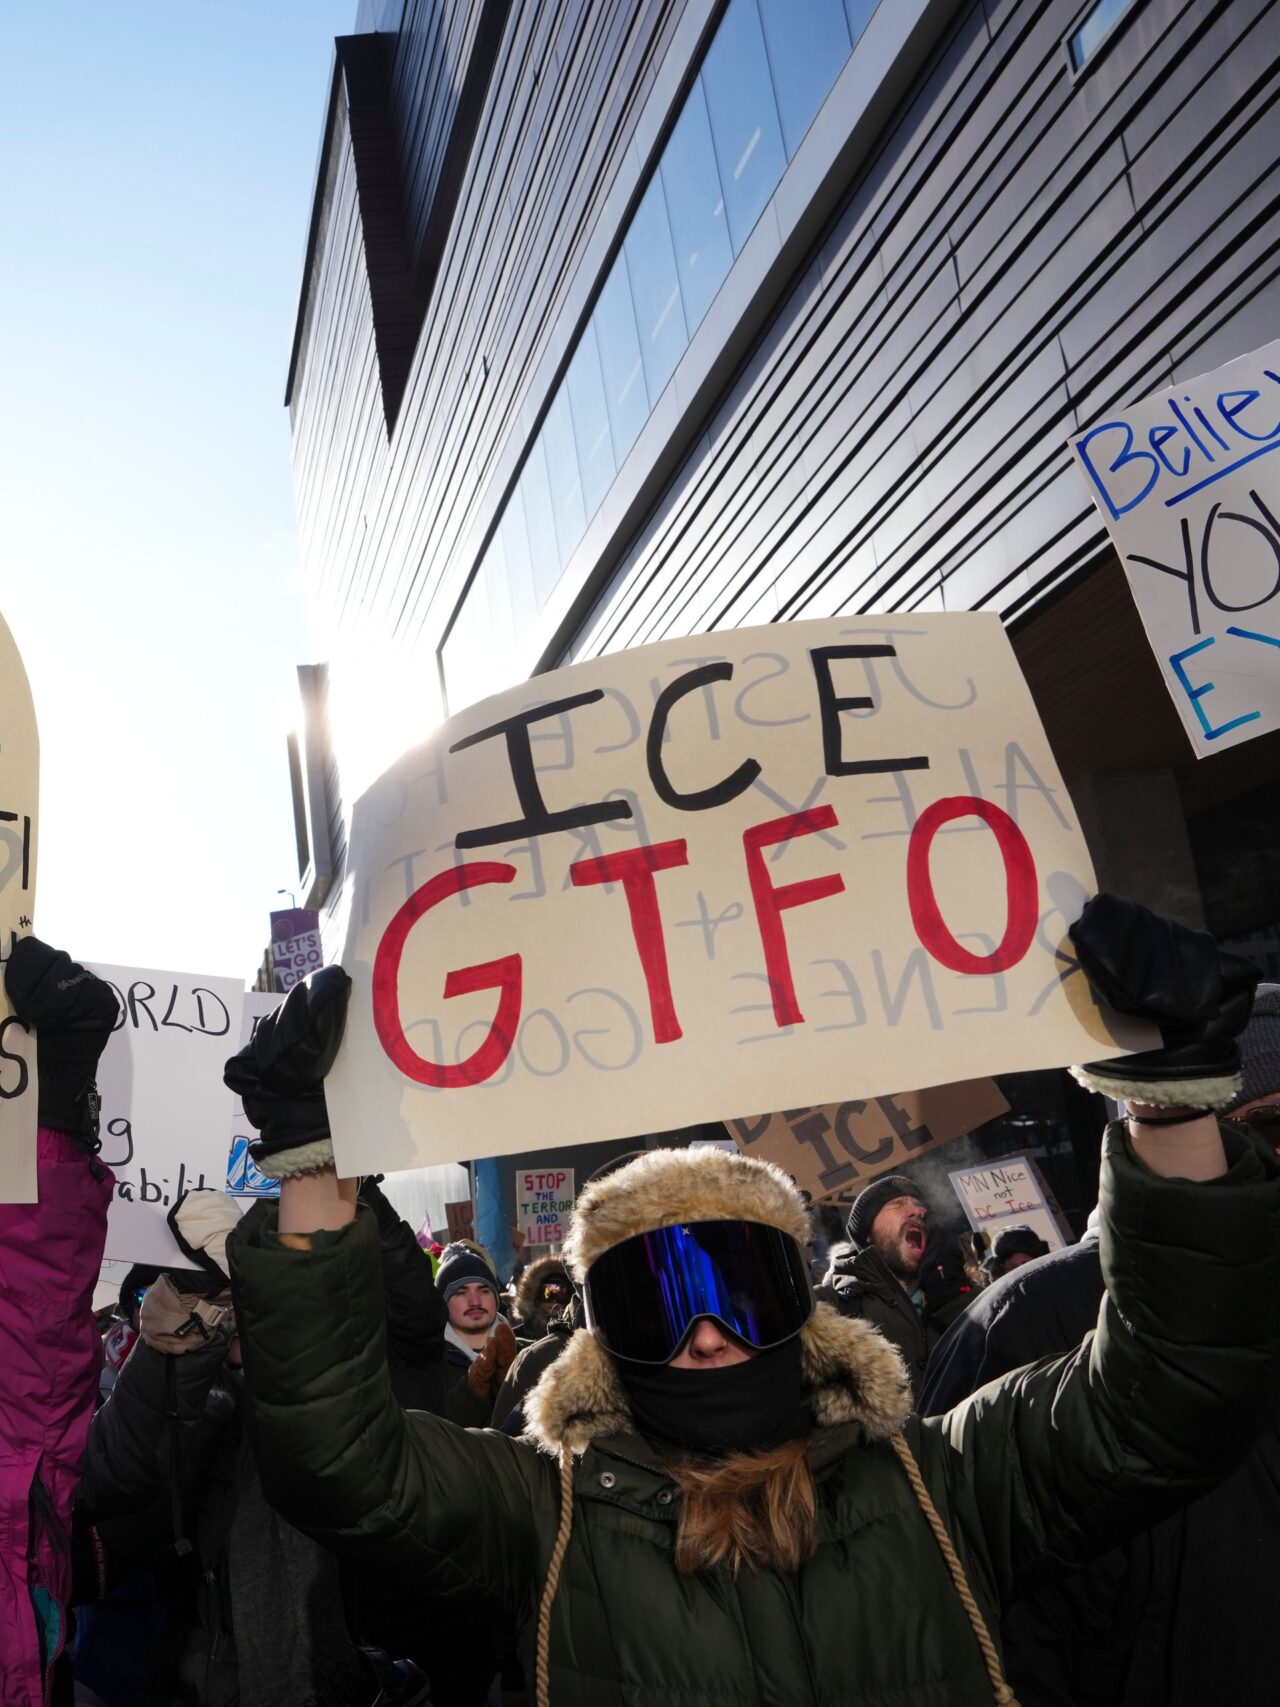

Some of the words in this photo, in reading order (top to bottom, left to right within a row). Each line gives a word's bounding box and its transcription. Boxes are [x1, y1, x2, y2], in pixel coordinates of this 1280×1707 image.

[1076, 370, 1280, 521] Belie
[449, 643, 929, 850] ICE
[278, 934, 317, 957] LET'S
[372, 795, 1038, 1088] GTFO
[293, 949, 320, 967] GO
[789, 1092, 934, 1191] ICE
[524, 1172, 566, 1191] STOP
[960, 1173, 990, 1195] MN
[991, 1168, 1027, 1188] Nice
[535, 1192, 554, 1200] THE
[994, 1186, 1014, 1200] not
[521, 1200, 573, 1215] TERROR
[975, 1205, 996, 1219] DC
[1005, 1199, 1035, 1214] Ice
[536, 1213, 558, 1224] AND
[527, 1224, 562, 1244] LIES
